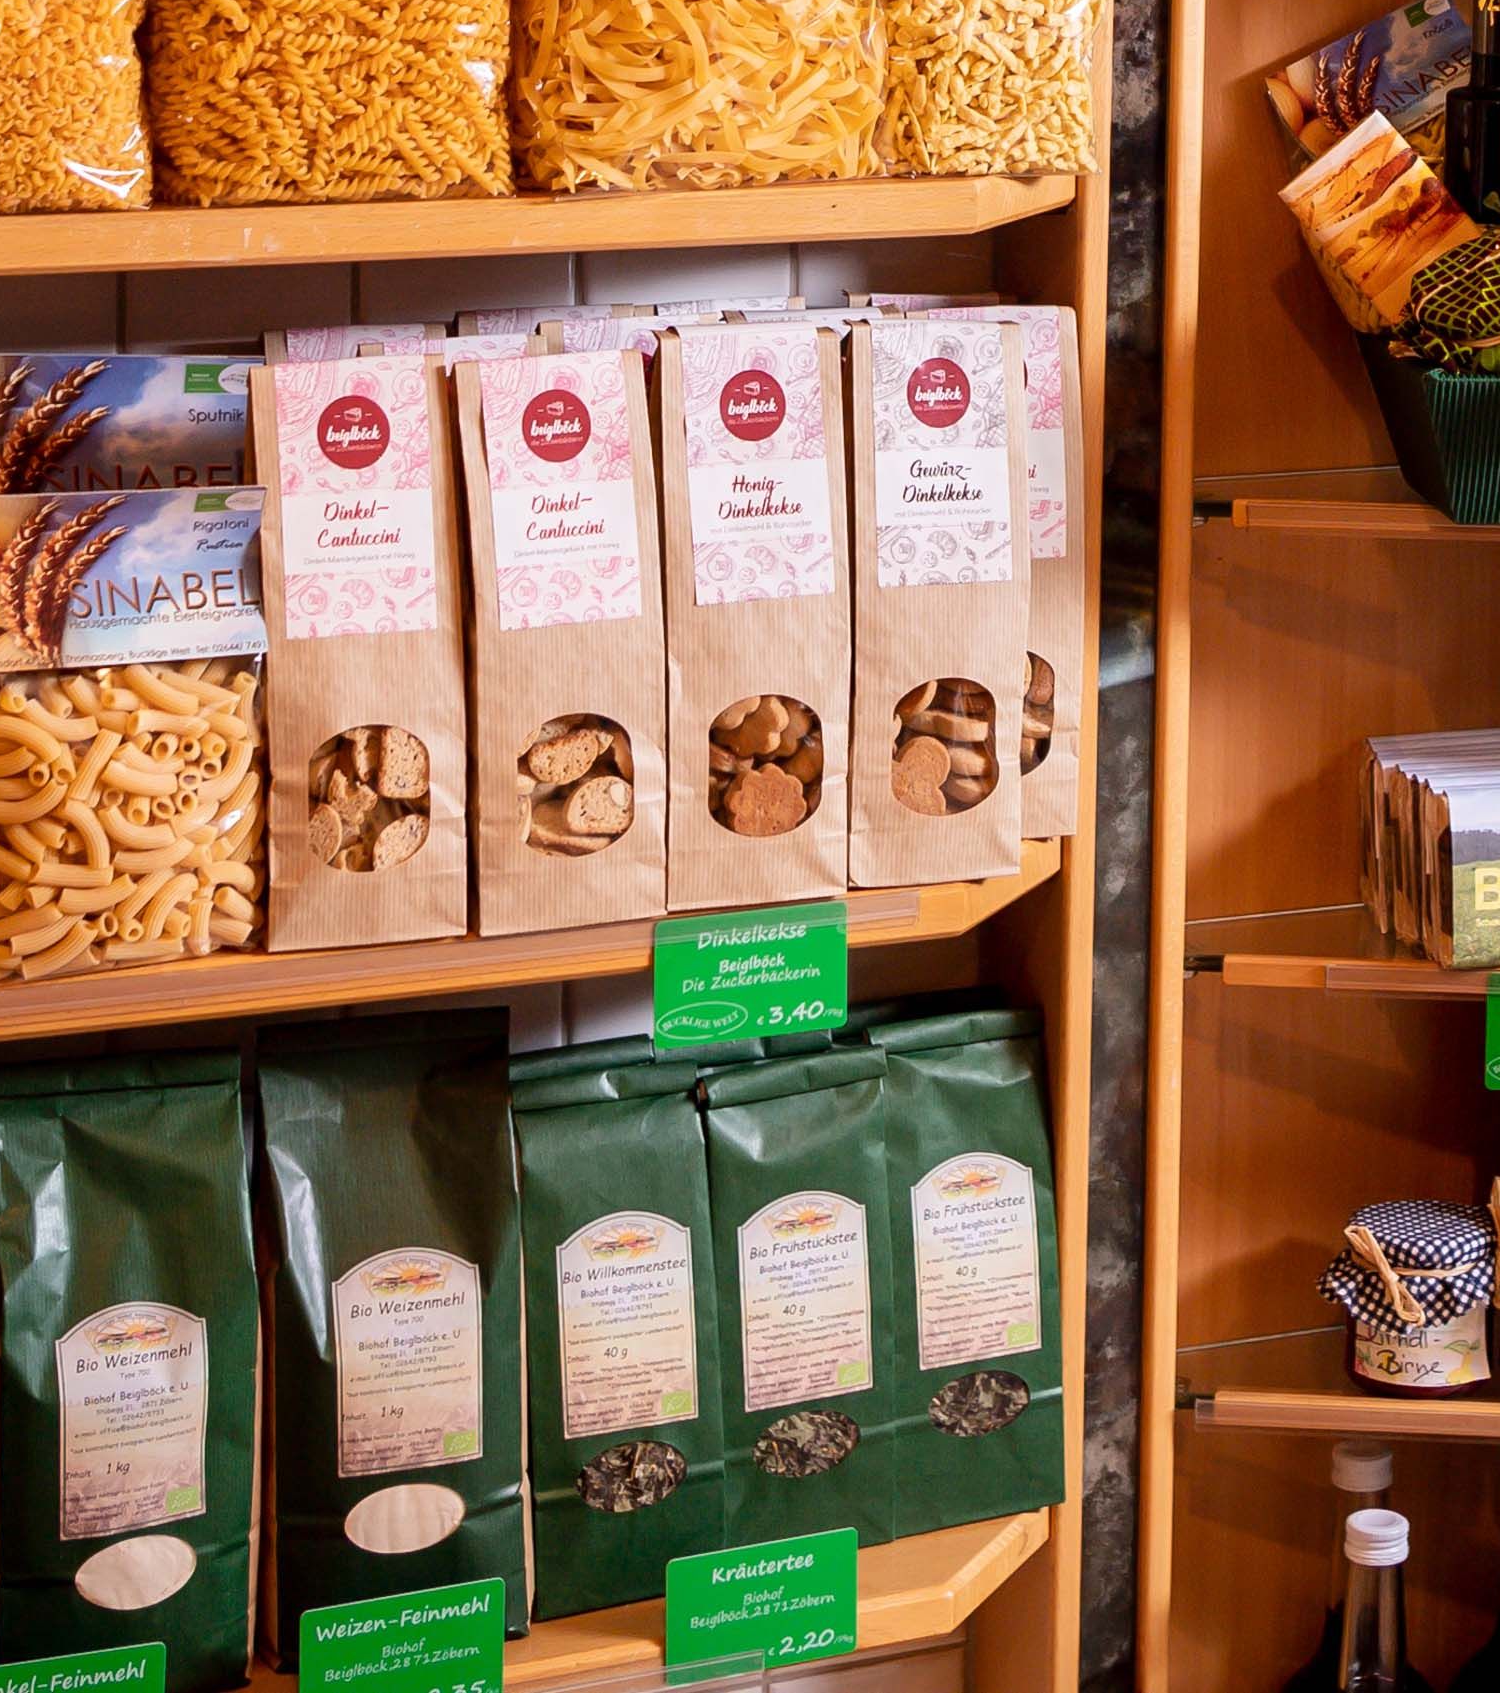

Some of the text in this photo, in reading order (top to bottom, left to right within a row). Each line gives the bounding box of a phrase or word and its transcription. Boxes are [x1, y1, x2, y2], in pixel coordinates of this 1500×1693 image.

[326, 424, 382, 443] beiglböck
[909, 459, 971, 479] Gewürz-
[732, 476, 783, 504] Honig-
[902, 482, 983, 504] Dinkelkekse
[324, 499, 389, 521] Dinkel-
[718, 497, 803, 520] Dinkelkekse
[317, 527, 401, 549] Cantuccini
[68, 568, 260, 618] SINABEL
[698, 923, 807, 950] Dinkelkekse
[719, 953, 785, 974] Beiglböck
[923, 1206, 941, 1221] Bio
[562, 1258, 686, 1285] Bio Willkommenstee
[75, 1341, 193, 1374] Bio Weizenmehl
[711, 1554, 814, 1584] Kräutertee
[743, 1586, 784, 1606] Biohof
[315, 1594, 492, 1644] Weizen-Feinmehl
